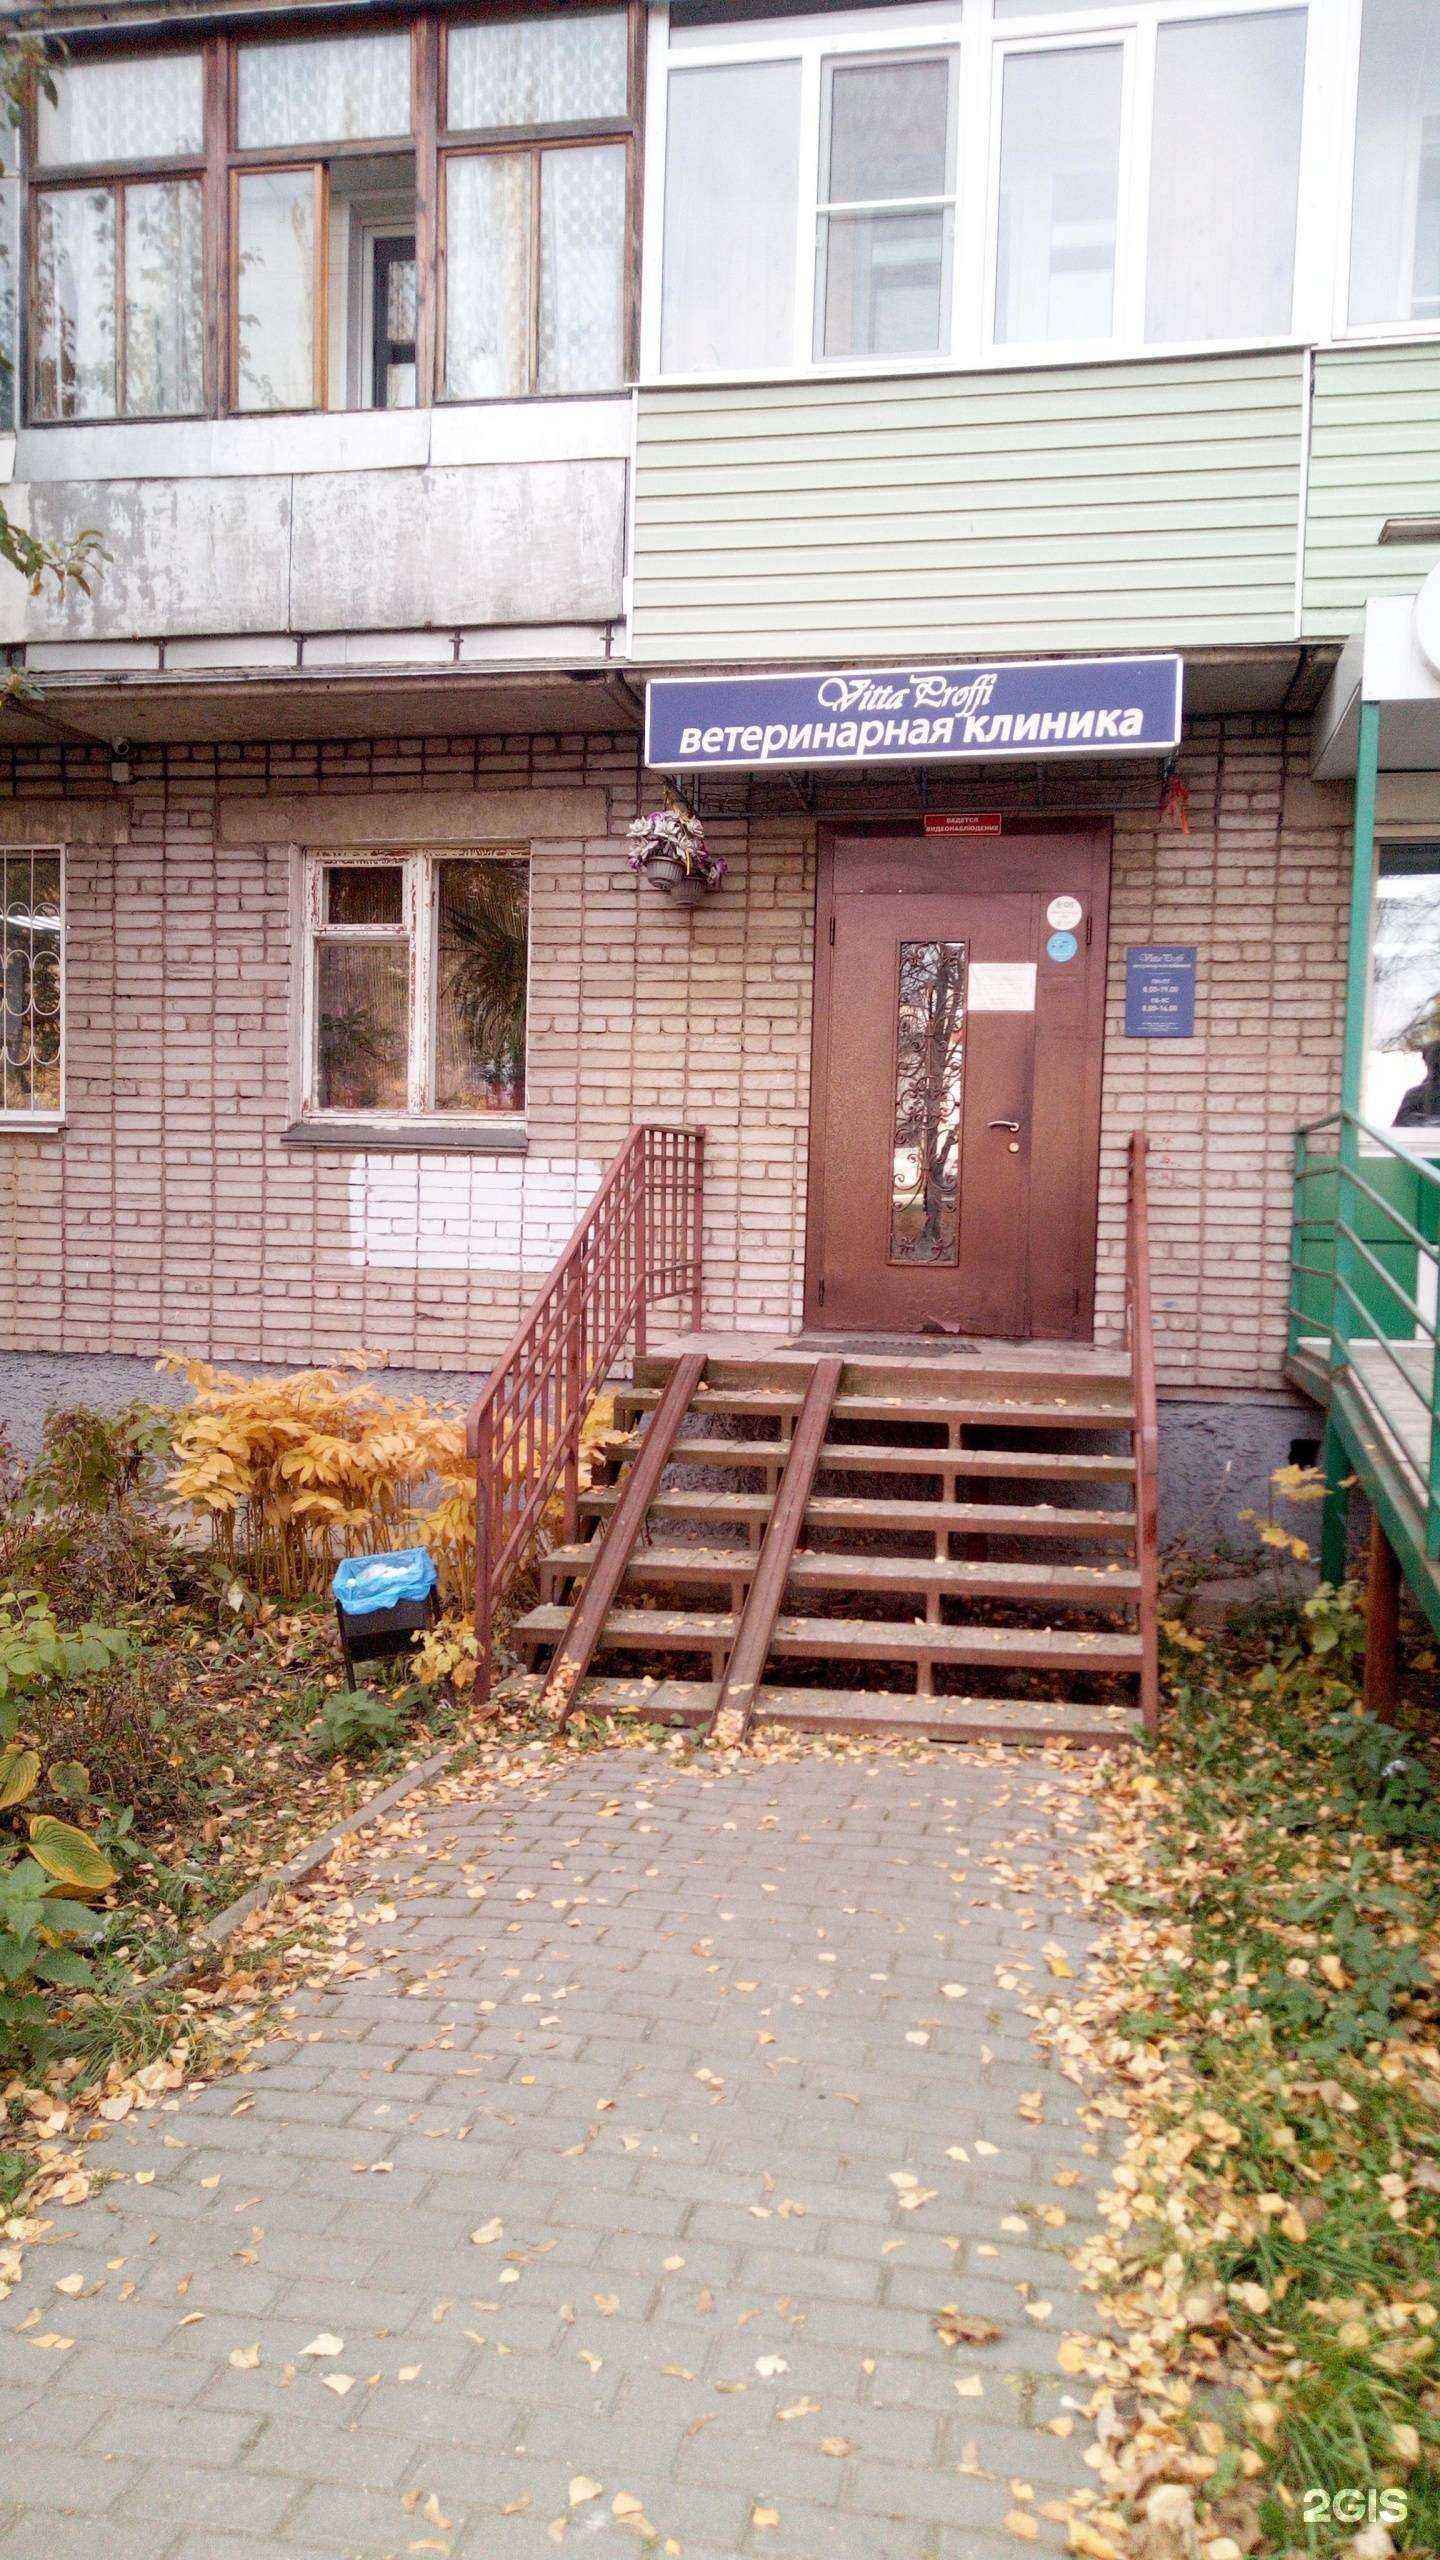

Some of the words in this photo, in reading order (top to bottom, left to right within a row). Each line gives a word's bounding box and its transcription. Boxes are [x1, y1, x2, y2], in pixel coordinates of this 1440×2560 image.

[818, 677, 910, 712] Vitta
[909, 673, 998, 718] Proffi
[679, 717, 954, 759] ветеринарная
[963, 707, 1144, 743] клиника
